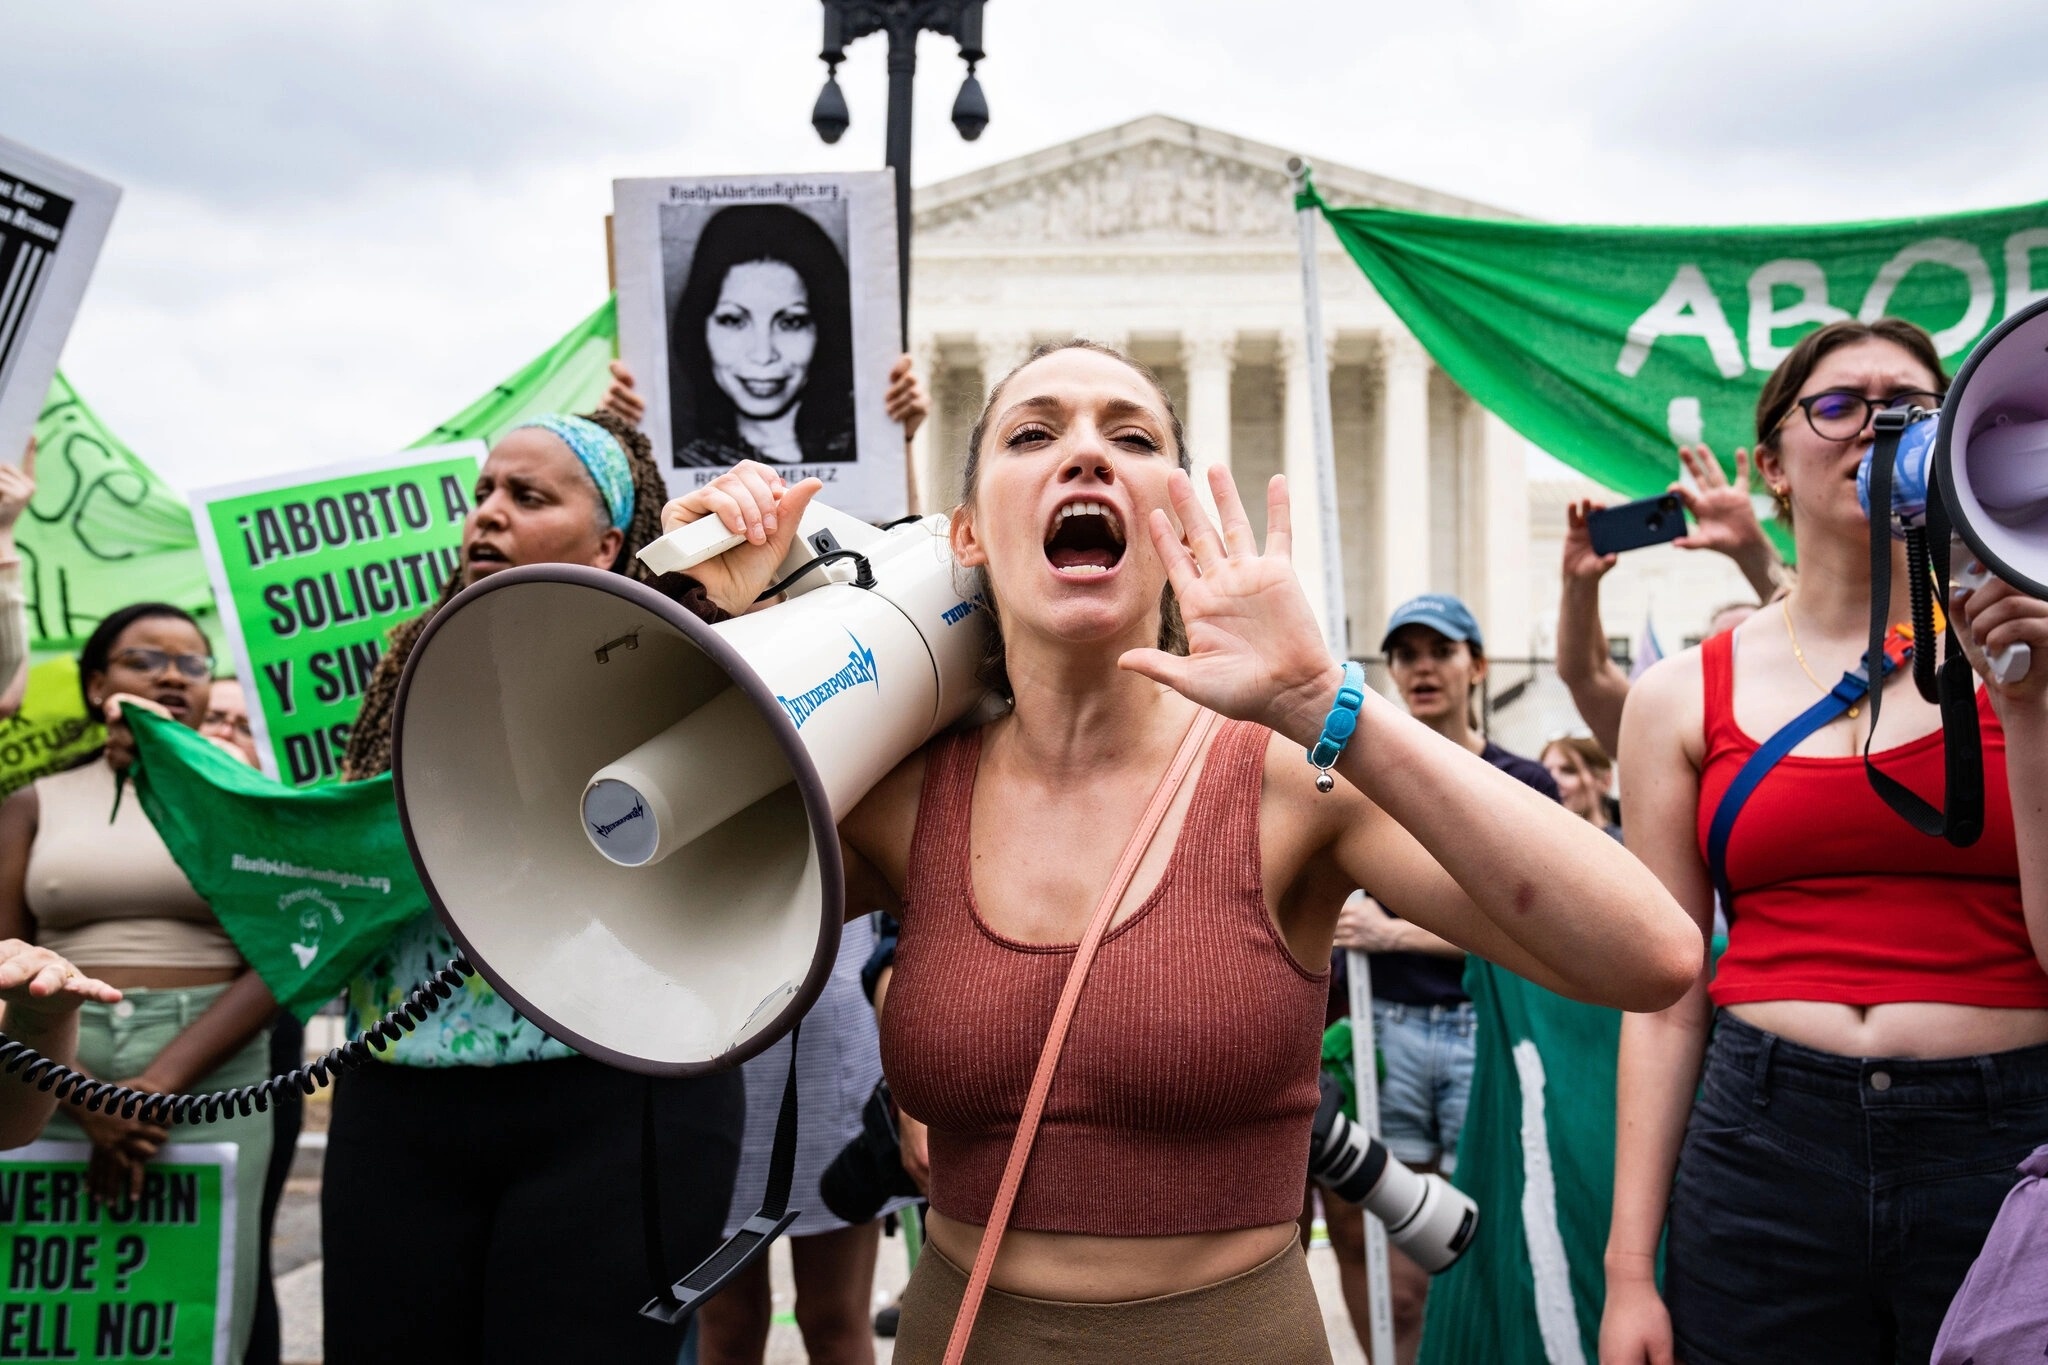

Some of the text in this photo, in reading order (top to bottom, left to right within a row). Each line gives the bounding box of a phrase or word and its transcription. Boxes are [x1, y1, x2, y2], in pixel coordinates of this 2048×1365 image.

[440, 475, 470, 525] A
[264, 640, 381, 714] Y SIN
[777, 647, 876, 730] THUNDERPOWER
[10, 1234, 148, 1292] ROE ?
[95, 1303, 177, 1359] NO!
